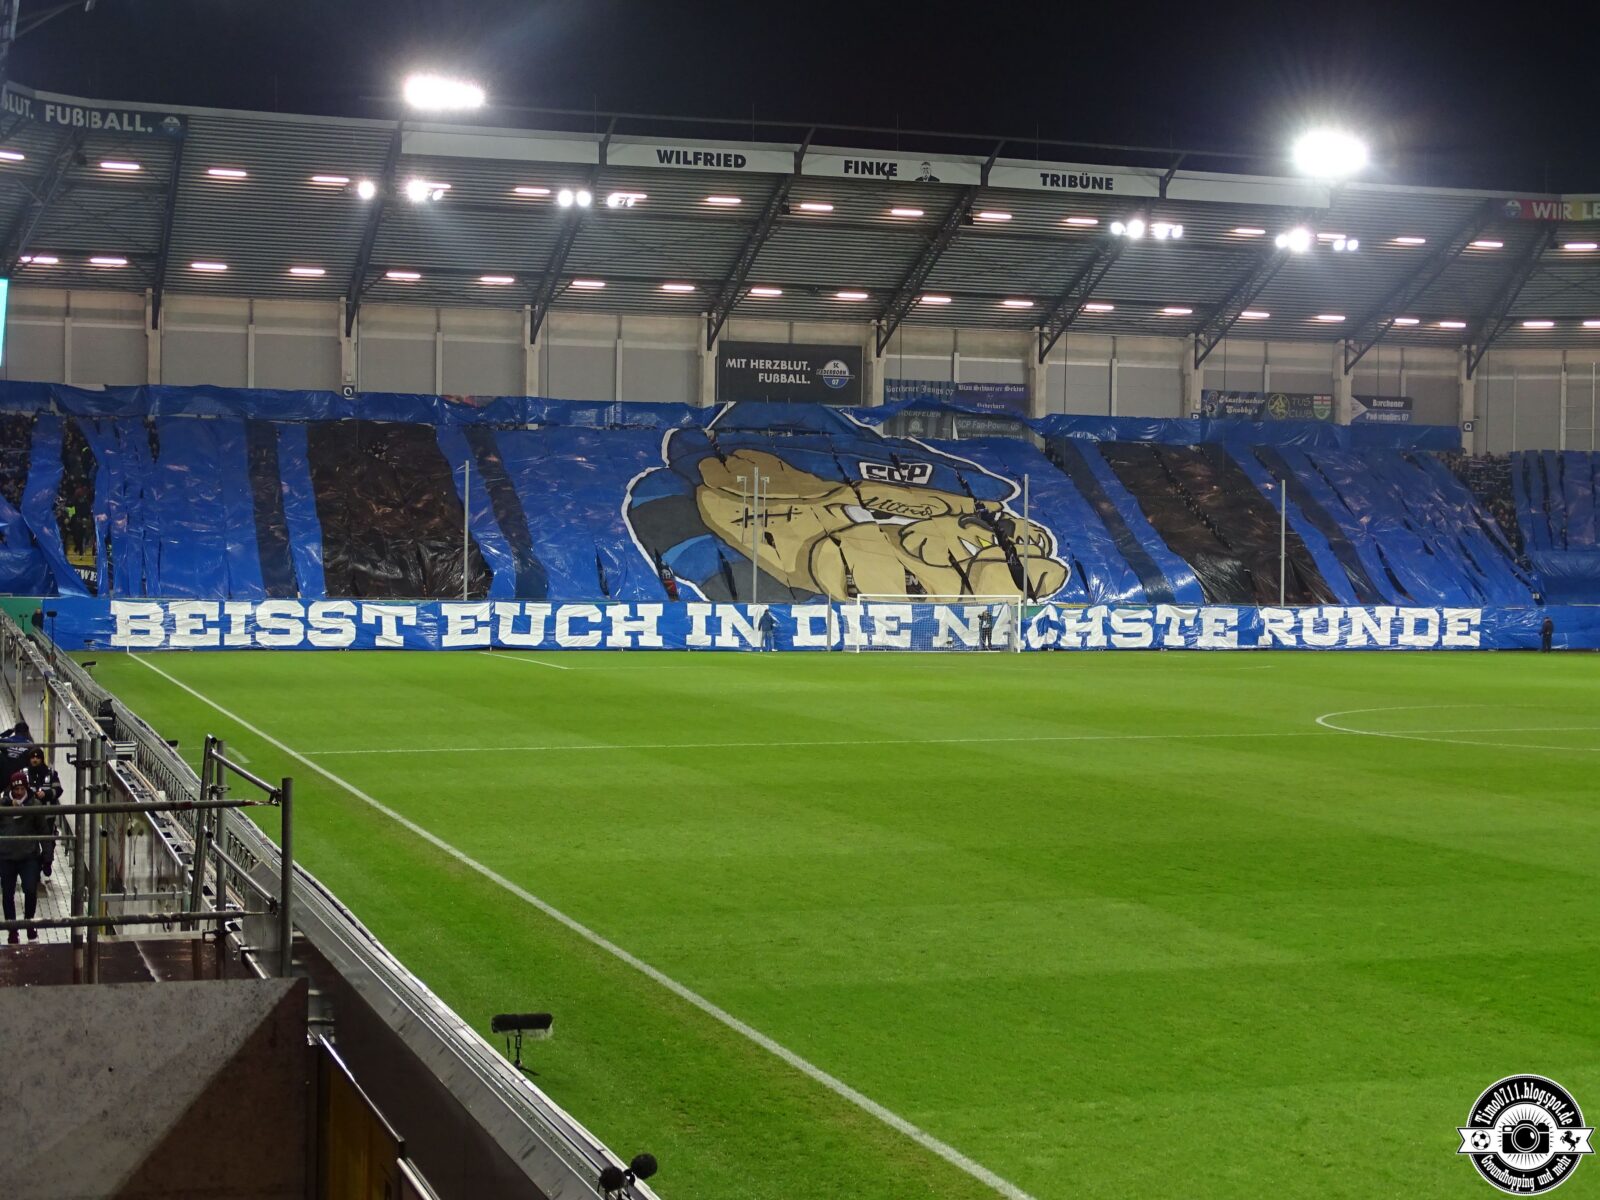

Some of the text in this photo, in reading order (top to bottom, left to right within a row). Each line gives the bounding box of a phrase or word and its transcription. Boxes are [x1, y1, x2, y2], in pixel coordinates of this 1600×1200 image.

[656, 149, 747, 169] WILFRIED
[843, 159, 899, 177] FINKE
[1040, 172, 1114, 191] TRIBÜNE
[1531, 201, 1573, 220] WIR
[725, 358, 811, 371] MIT HERZBLUT.
[110, 600, 417, 648] BEISST
[441, 602, 663, 648] EUCH
[686, 602, 769, 648] IN
[790, 604, 913, 648] DIE
[1257, 606, 1483, 647] RUNDE
